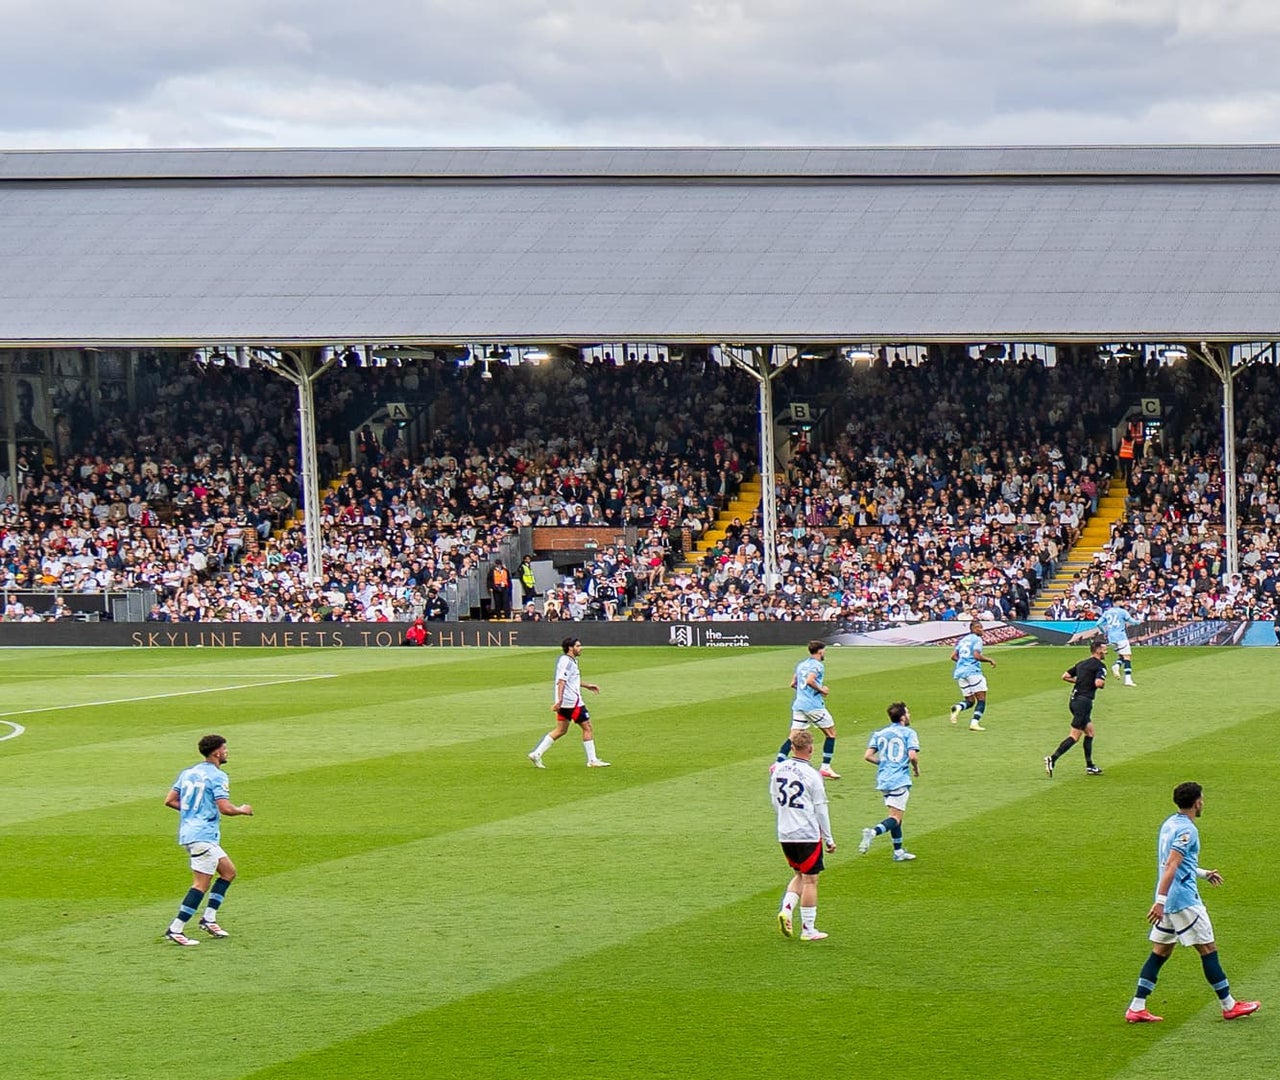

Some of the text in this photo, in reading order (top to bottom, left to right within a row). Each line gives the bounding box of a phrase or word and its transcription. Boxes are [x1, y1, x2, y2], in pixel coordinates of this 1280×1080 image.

[393, 406, 405, 417] A
[794, 406, 806, 418] B
[1145, 401, 1156, 413] C
[1107, 614, 1121, 627] 24
[132, 632, 242, 647] SKYLINE
[261, 632, 343, 647] MEETS
[705, 629, 722, 639] the
[877, 736, 905, 762] 20
[181, 780, 206, 811] 27
[776, 777, 804, 809] 32
